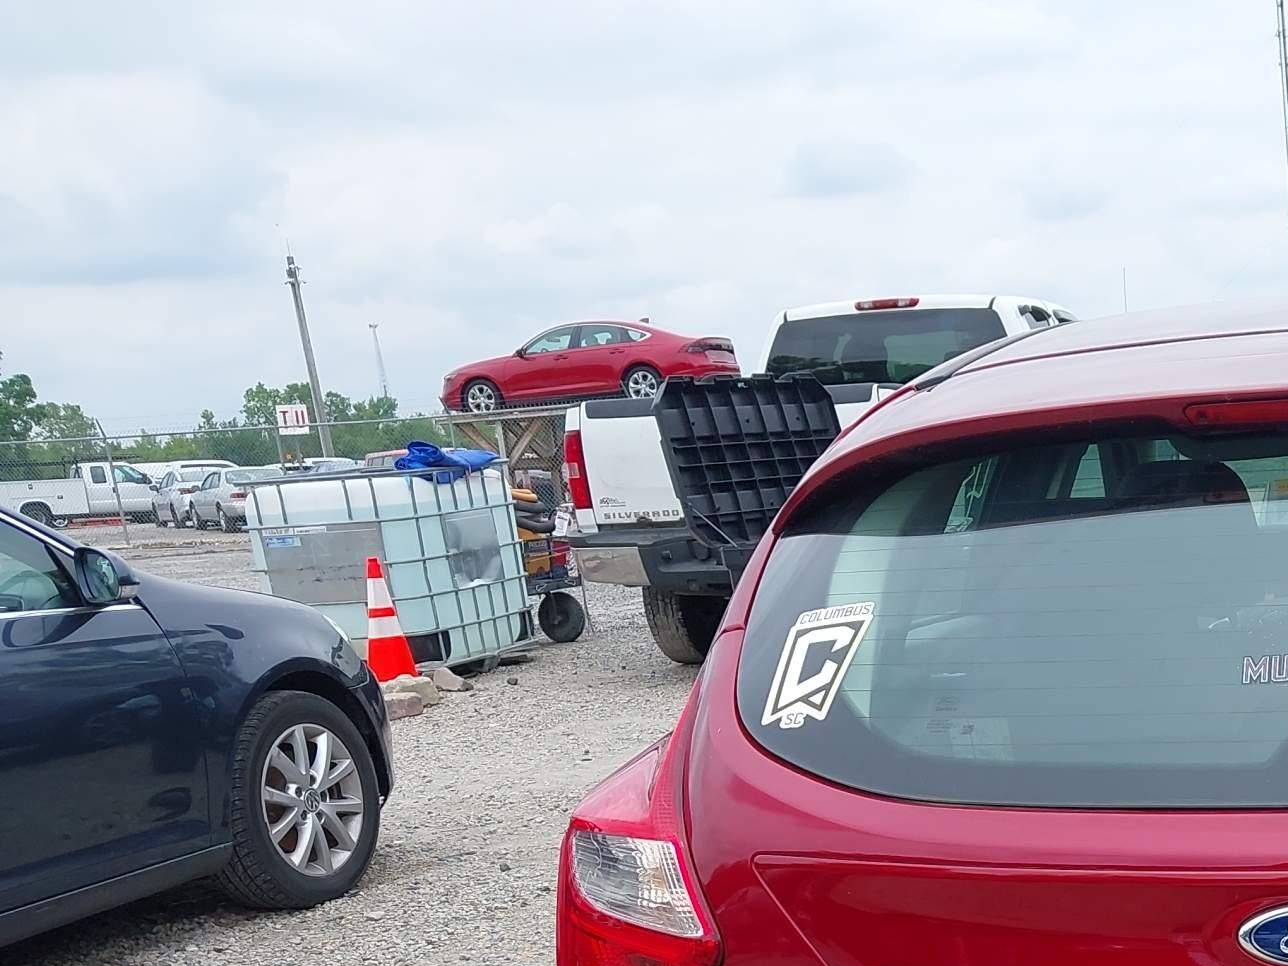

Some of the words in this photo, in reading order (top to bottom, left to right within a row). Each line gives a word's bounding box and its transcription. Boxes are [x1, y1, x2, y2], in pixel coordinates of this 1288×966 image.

[279, 411, 288, 425] T
[603, 509, 680, 520] SILVERADO
[800, 605, 871, 625] COLUMBUS
